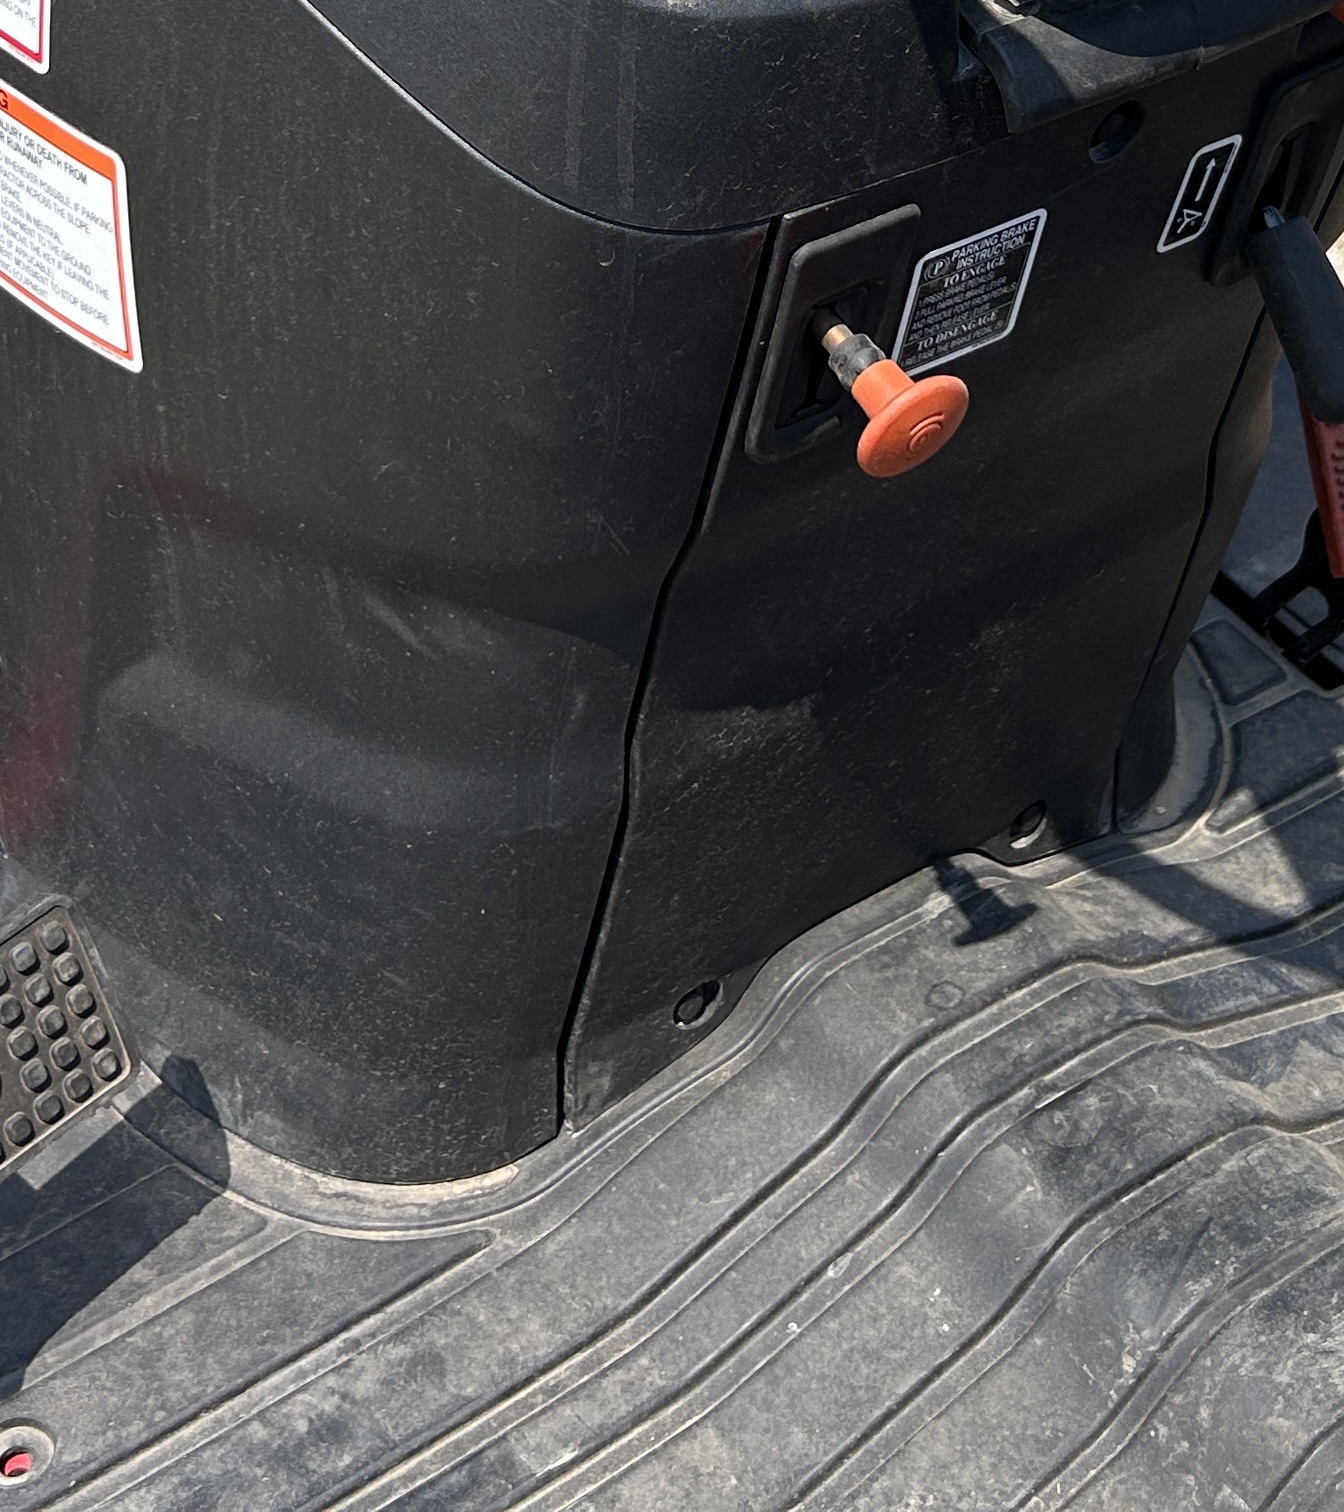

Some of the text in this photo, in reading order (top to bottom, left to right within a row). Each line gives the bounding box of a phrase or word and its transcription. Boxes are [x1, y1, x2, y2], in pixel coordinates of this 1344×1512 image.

[23, 133, 35, 151] OR
[36, 142, 61, 169] DEATH
[62, 159, 88, 186] FROM
[950, 217, 1037, 262] PARKING BRAKE
[955, 233, 1026, 270] INSTRUCTION
[941, 253, 1008, 288] TO ENGAGE
[916, 335, 934, 351] TO
[934, 309, 999, 344] DISENGAGE
